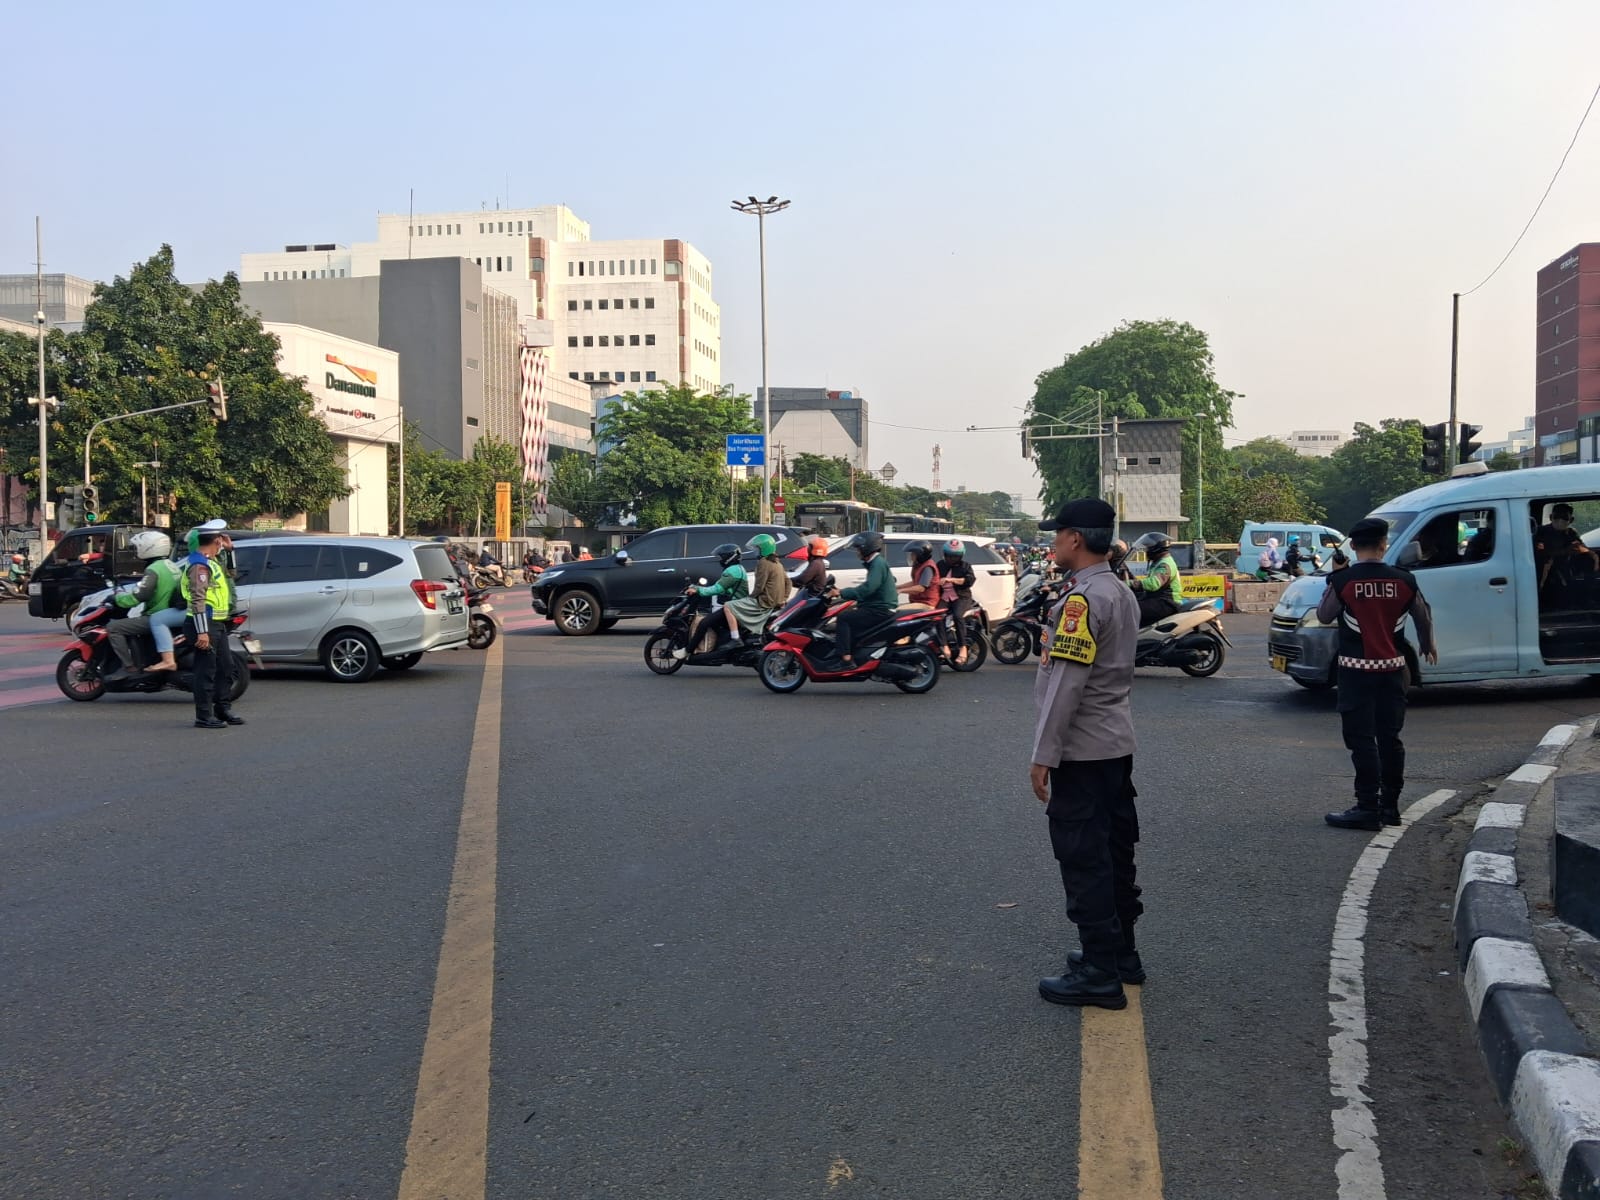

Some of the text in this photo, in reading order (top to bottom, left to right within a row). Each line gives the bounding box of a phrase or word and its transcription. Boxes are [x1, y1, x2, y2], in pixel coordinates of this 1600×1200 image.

[325, 371, 377, 399] Danamon
[1183, 585, 1220, 593] POWER
[1355, 582, 1398, 600] POLISI
